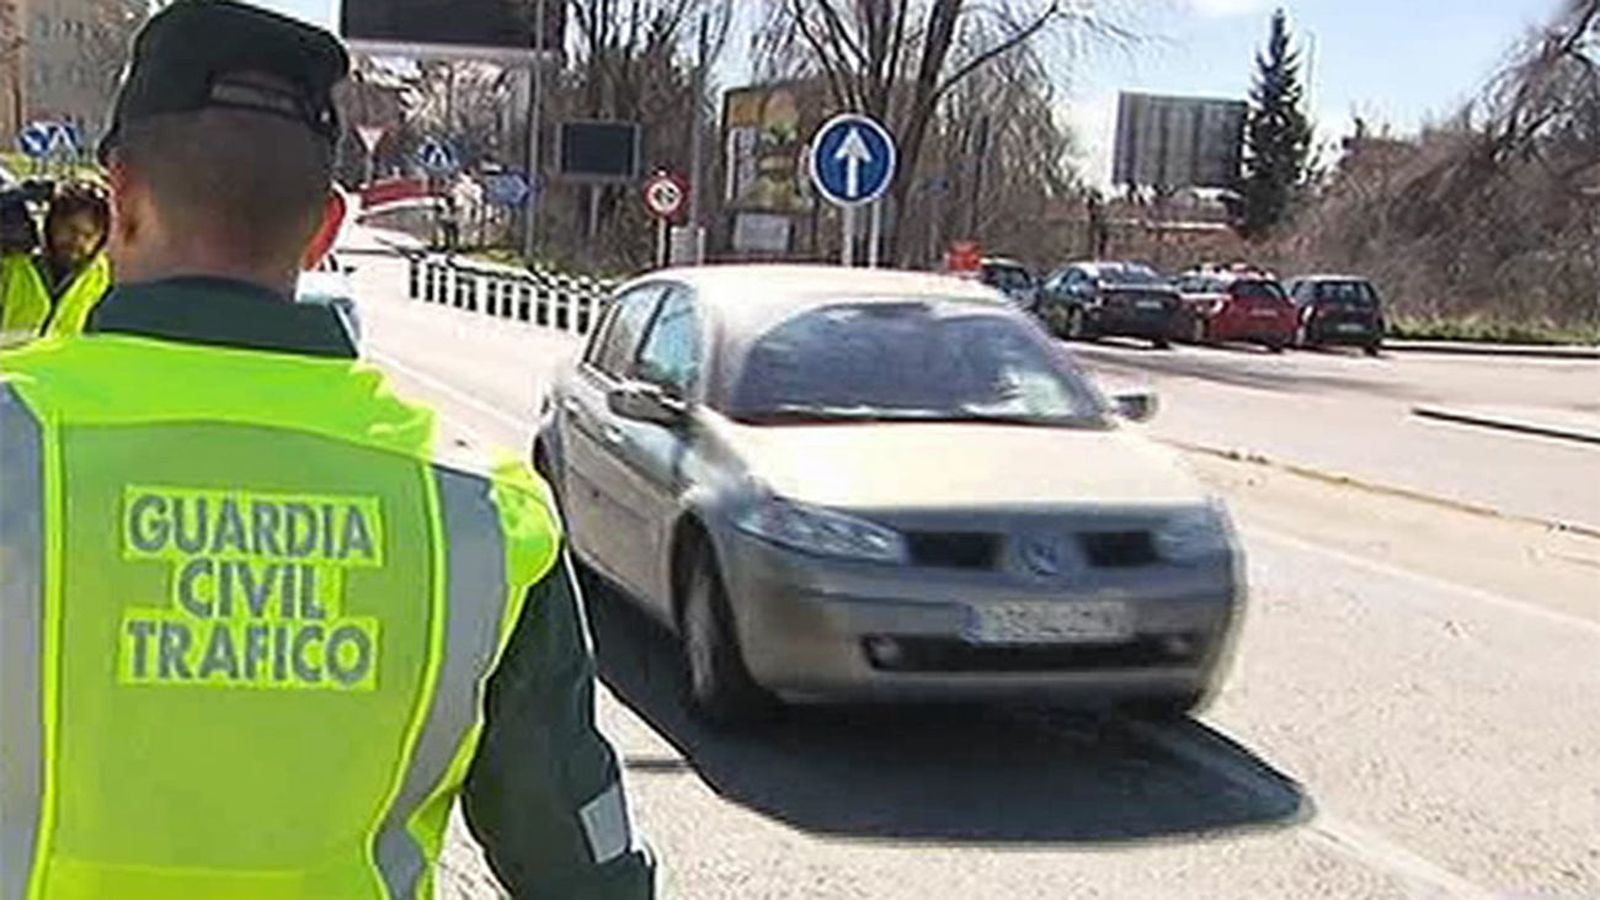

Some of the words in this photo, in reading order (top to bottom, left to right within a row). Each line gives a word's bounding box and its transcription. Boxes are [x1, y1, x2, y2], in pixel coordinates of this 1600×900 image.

[130, 494, 374, 559] GUARDIA
[179, 558, 325, 619] CIVIL
[128, 621, 371, 685] TRAFICO
